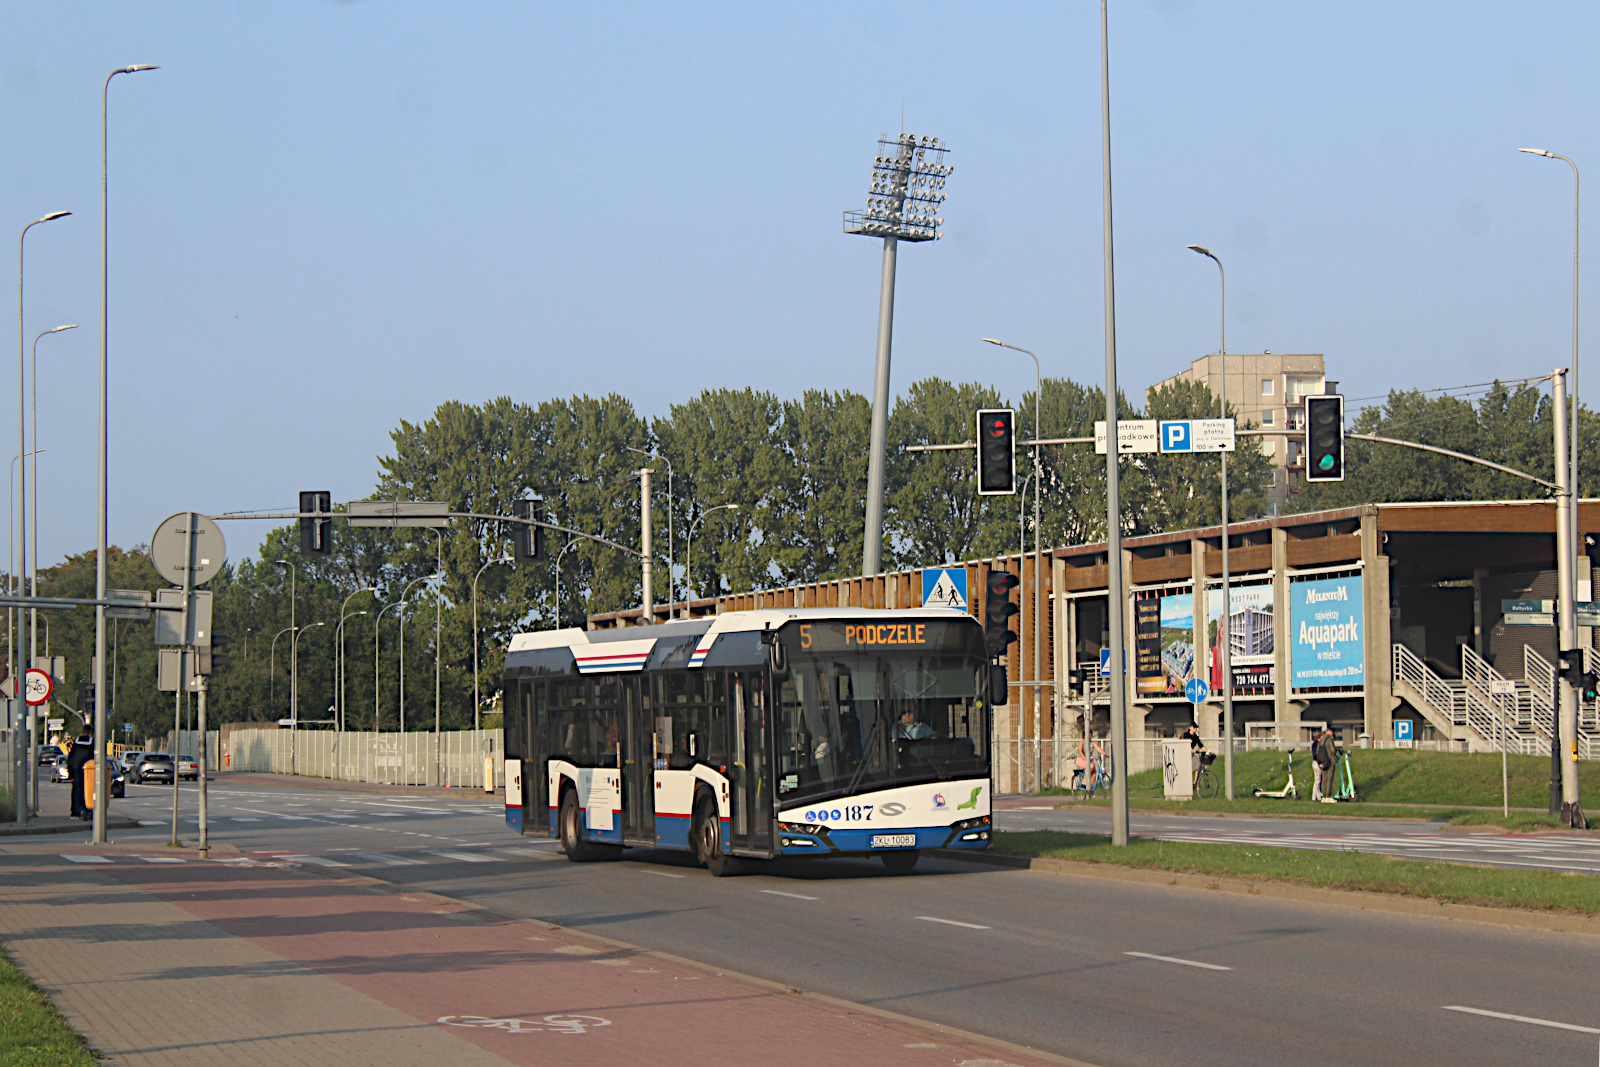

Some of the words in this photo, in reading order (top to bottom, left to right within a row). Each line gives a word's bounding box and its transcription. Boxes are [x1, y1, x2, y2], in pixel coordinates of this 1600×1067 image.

[1168, 425, 1185, 448] P
[1315, 609, 1339, 622] największy
[800, 624, 812, 648] 5
[845, 624, 926, 645] PODCZELE
[1299, 616, 1358, 650] Aquapark
[1323, 649, 1341, 660] mieście
[1236, 675, 1246, 685] 720
[1247, 675, 1258, 684] 744
[1259, 674, 1269, 684] 477
[1398, 722, 1409, 738] P
[845, 805, 873, 821] 187
[874, 836, 889, 845] ZKL
[891, 835, 915, 845] 10083
